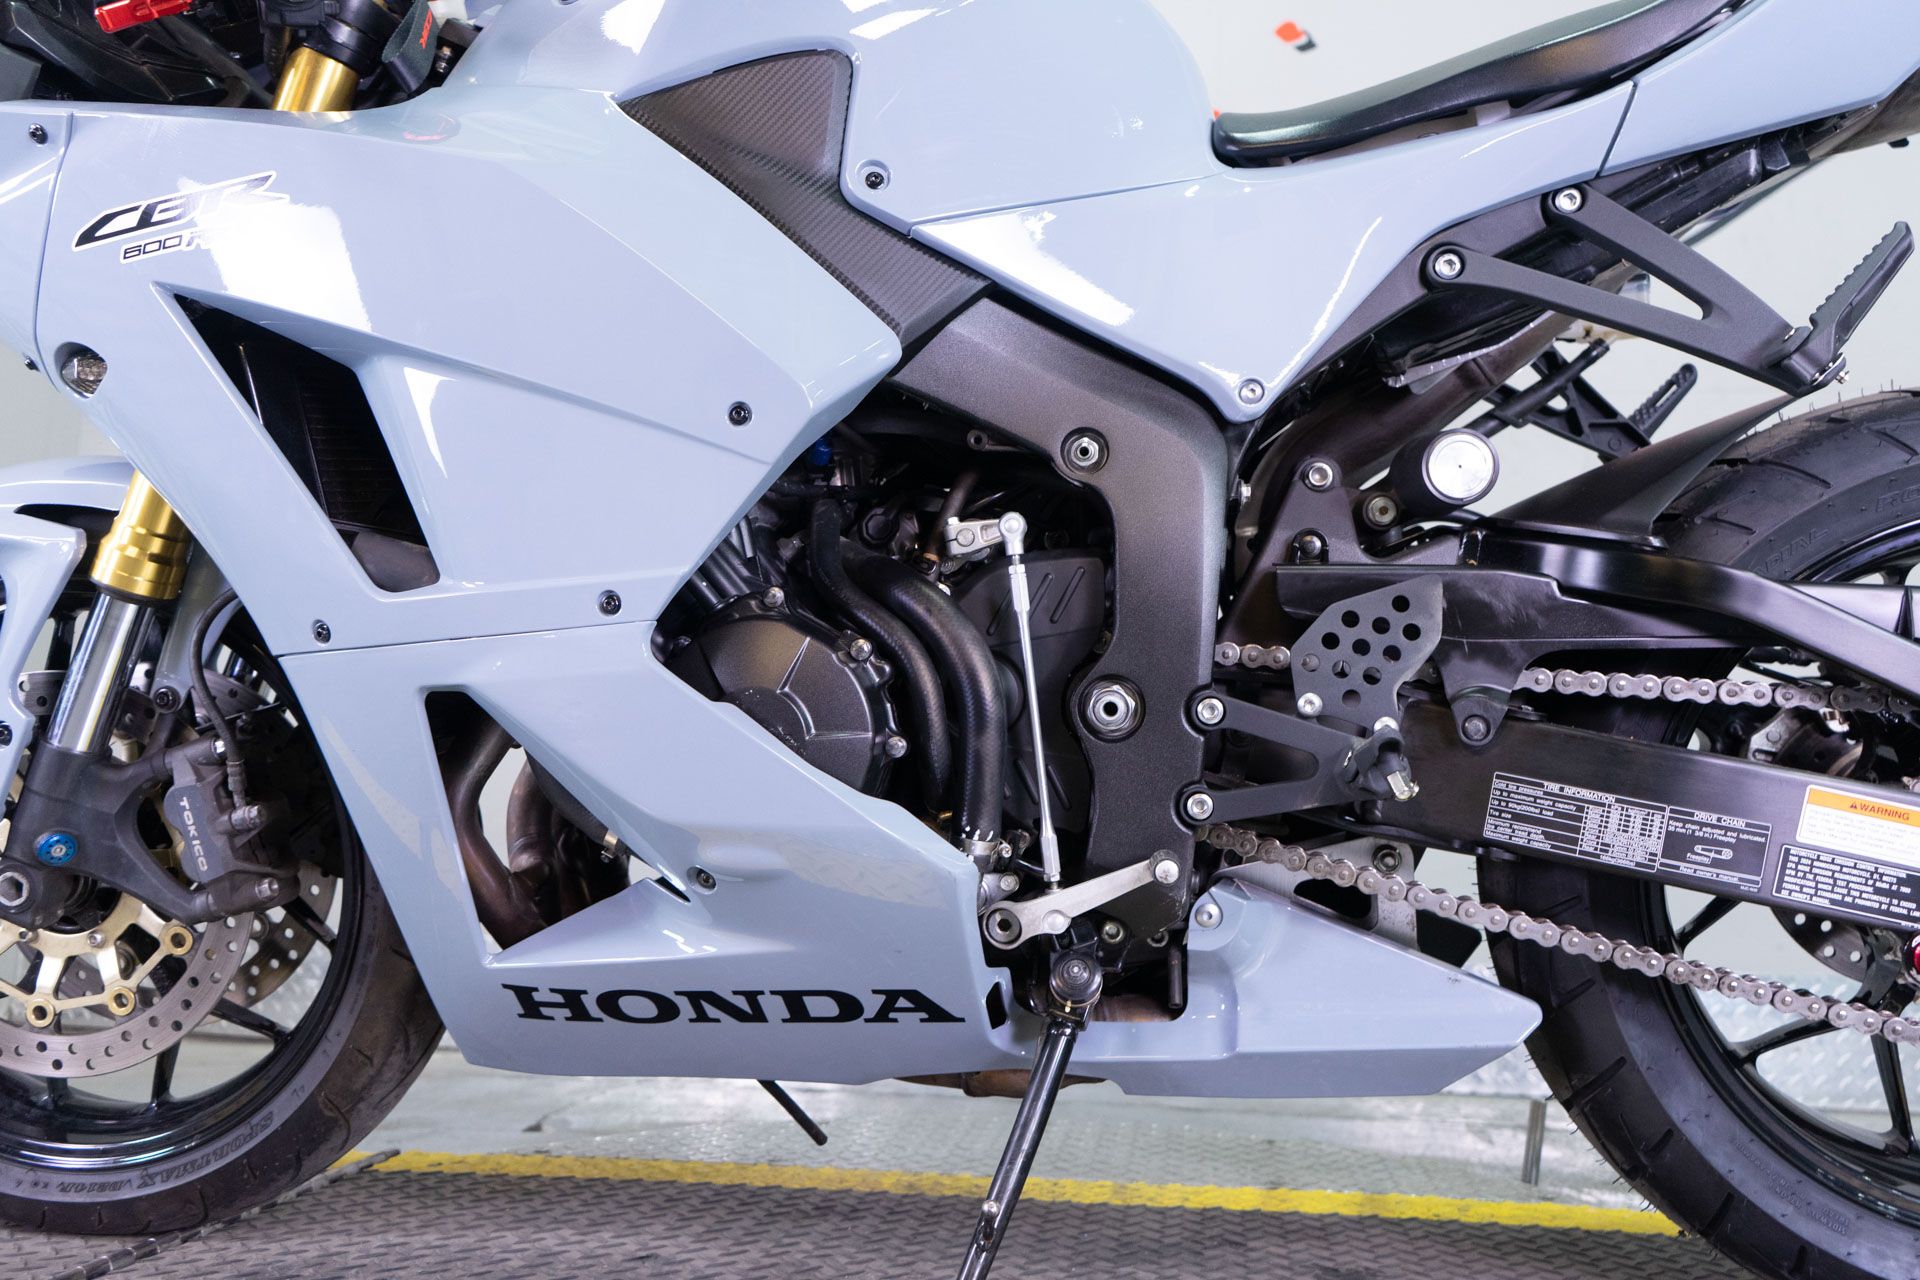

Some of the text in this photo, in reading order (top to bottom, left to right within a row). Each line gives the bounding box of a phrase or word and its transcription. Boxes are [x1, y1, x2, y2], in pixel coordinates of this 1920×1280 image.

[1544, 782, 1615, 803] TIRE INFORMATION
[1694, 812, 1746, 828] DRIVE CHAIN
[1860, 802, 1910, 821] WARNING
[180, 796, 208, 872] TOKICO
[1669, 820, 1683, 828] Keep
[1685, 823, 1700, 831] chain
[1702, 826, 1725, 836] adjusted
[1727, 830, 1738, 838] and
[1713, 833, 1737, 844] Freeplay
[501, 983, 966, 1024] HONDA
